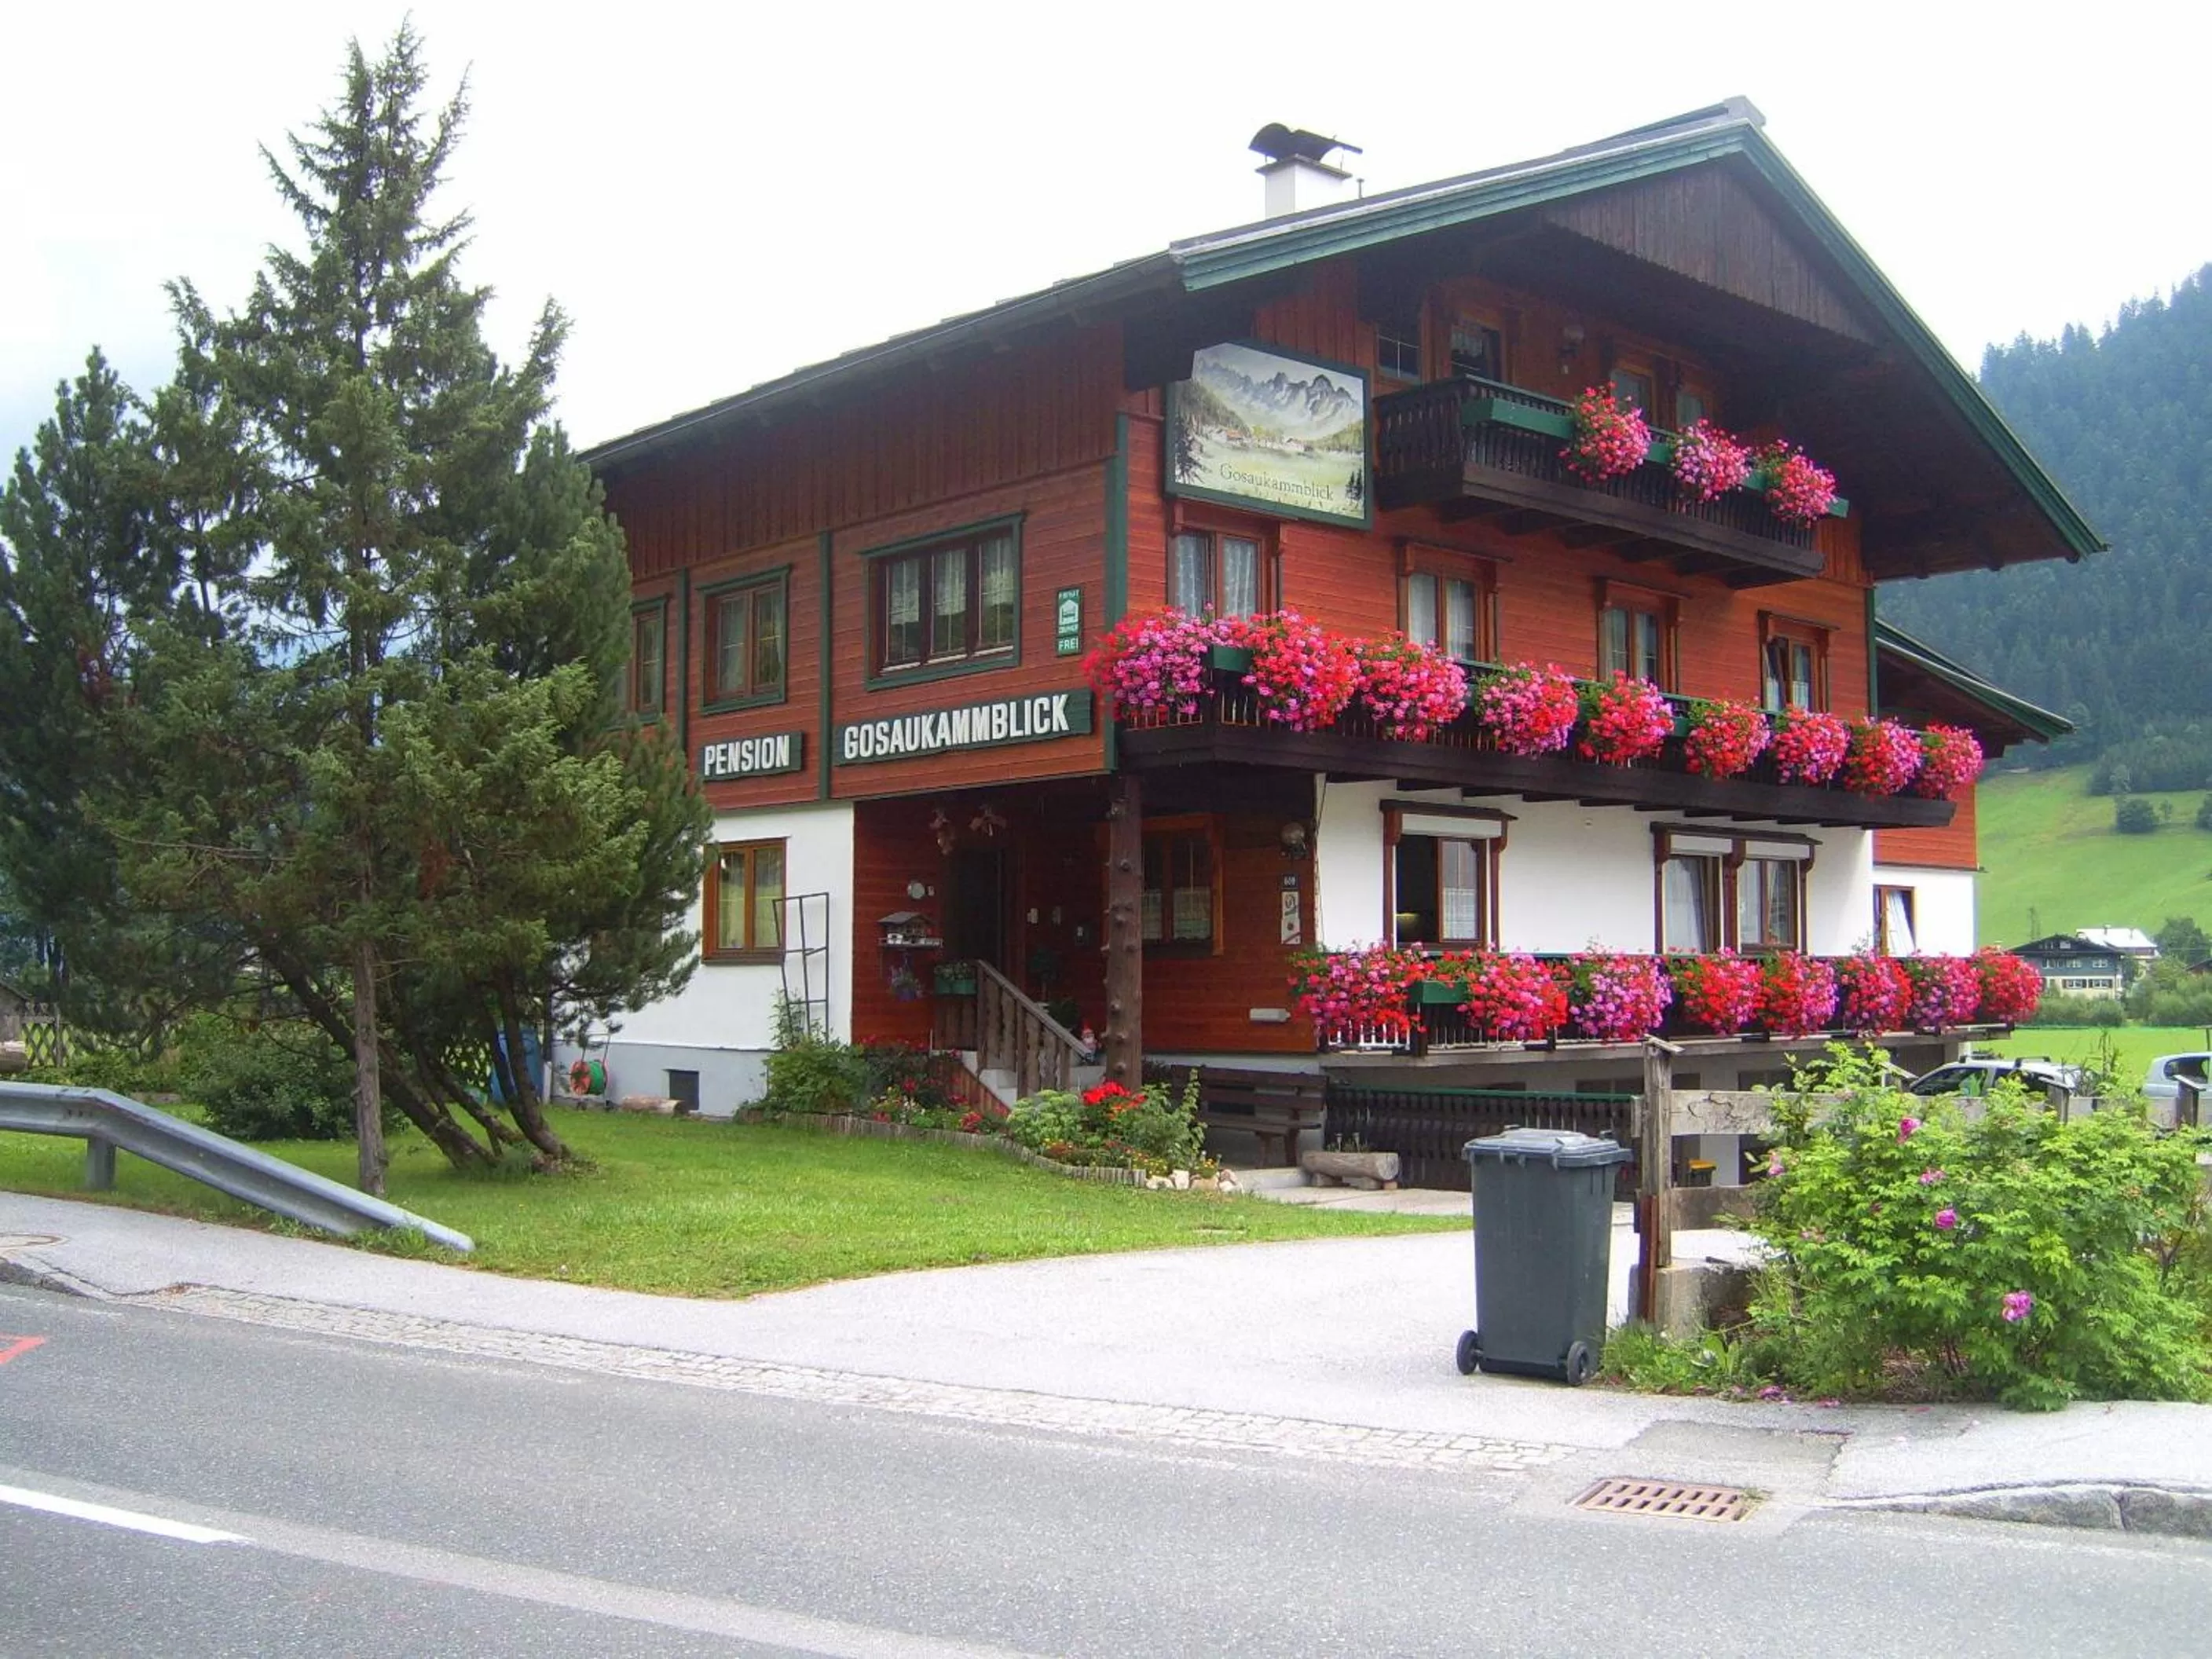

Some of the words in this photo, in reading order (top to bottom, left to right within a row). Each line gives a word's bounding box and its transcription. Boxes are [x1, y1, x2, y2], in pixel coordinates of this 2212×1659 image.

[1220, 463, 1334, 500] Gosaukammblick
[1058, 637, 1079, 651] FREI
[704, 735, 790, 776] PENSION
[844, 694, 1070, 760] GOSAUKAMMBLICK
